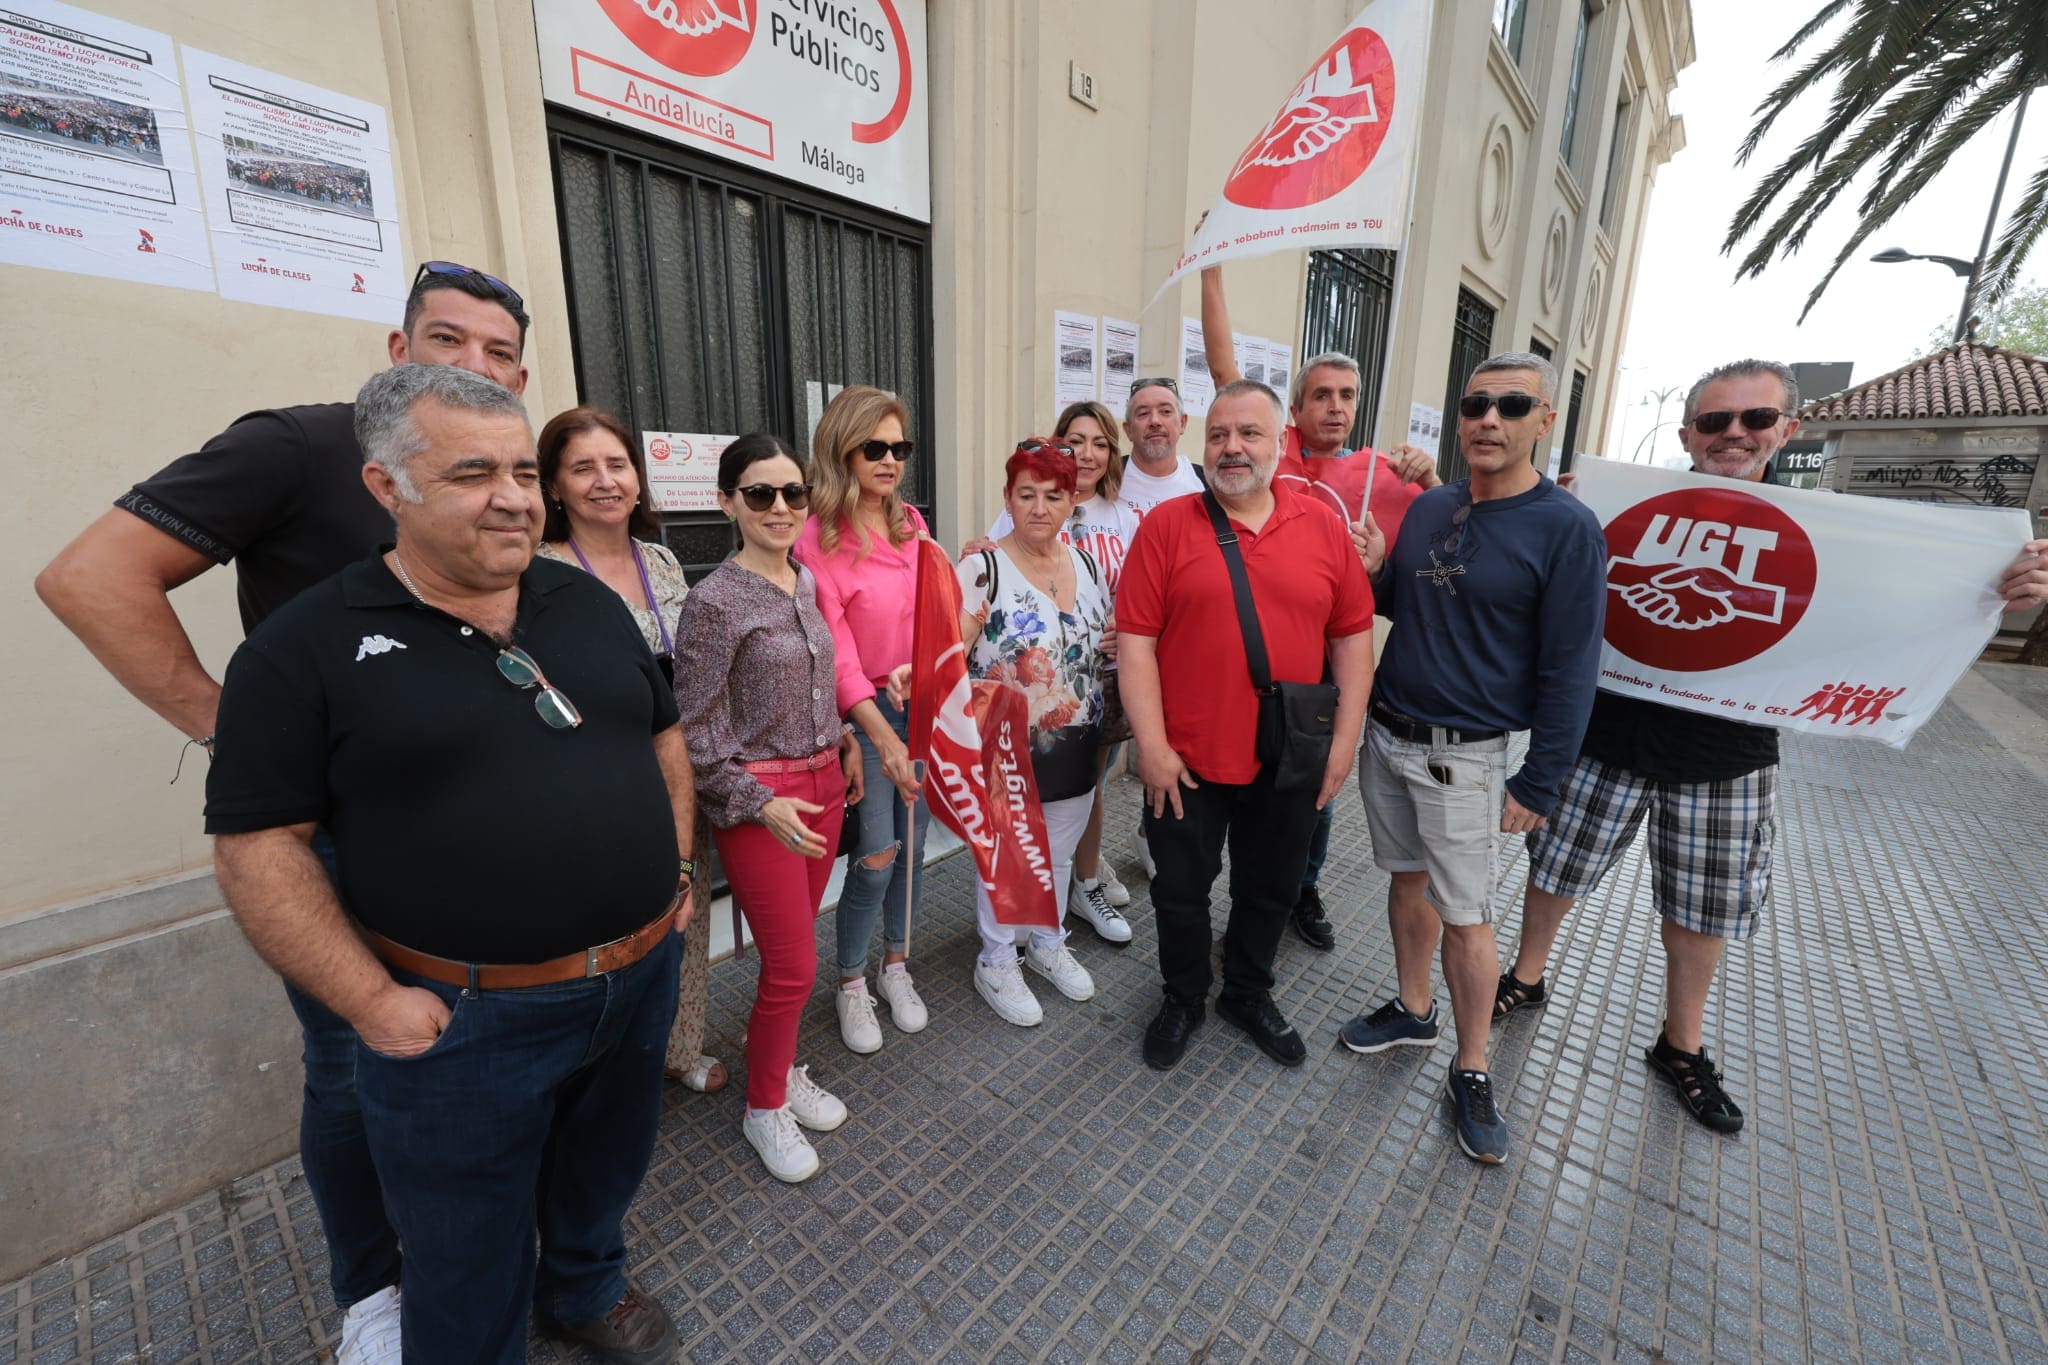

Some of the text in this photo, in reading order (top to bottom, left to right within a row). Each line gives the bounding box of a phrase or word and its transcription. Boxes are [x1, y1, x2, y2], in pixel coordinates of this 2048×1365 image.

[9, 15, 86, 41] CHARLA DEBATE
[9, 37, 73, 60] SOCIALISMO
[76, 55, 96, 66] HOY
[57, 42, 69, 51] LA
[72, 47, 105, 61] LUCHA
[108, 57, 129, 68] POR
[771, 11, 880, 93] Públicos
[1081, 72, 1092, 99] 19
[234, 97, 291, 118] SINDICALISMO
[624, 80, 735, 140] Andalucía
[264, 113, 310, 131] SOCIALISMO
[801, 141, 865, 184] Málaga
[28, 221, 42, 232] DE
[45, 224, 83, 238] CLASES
[241, 262, 311, 281] LUCHA DE CLASES
[1787, 452, 1822, 469] 11:16
[140, 503, 217, 551] CALVIN KLEIN
[1633, 513, 1779, 585] UGT
[1601, 668, 1789, 716] miembro fundador de la CES
[999, 720, 1053, 892] www.ugt.es
